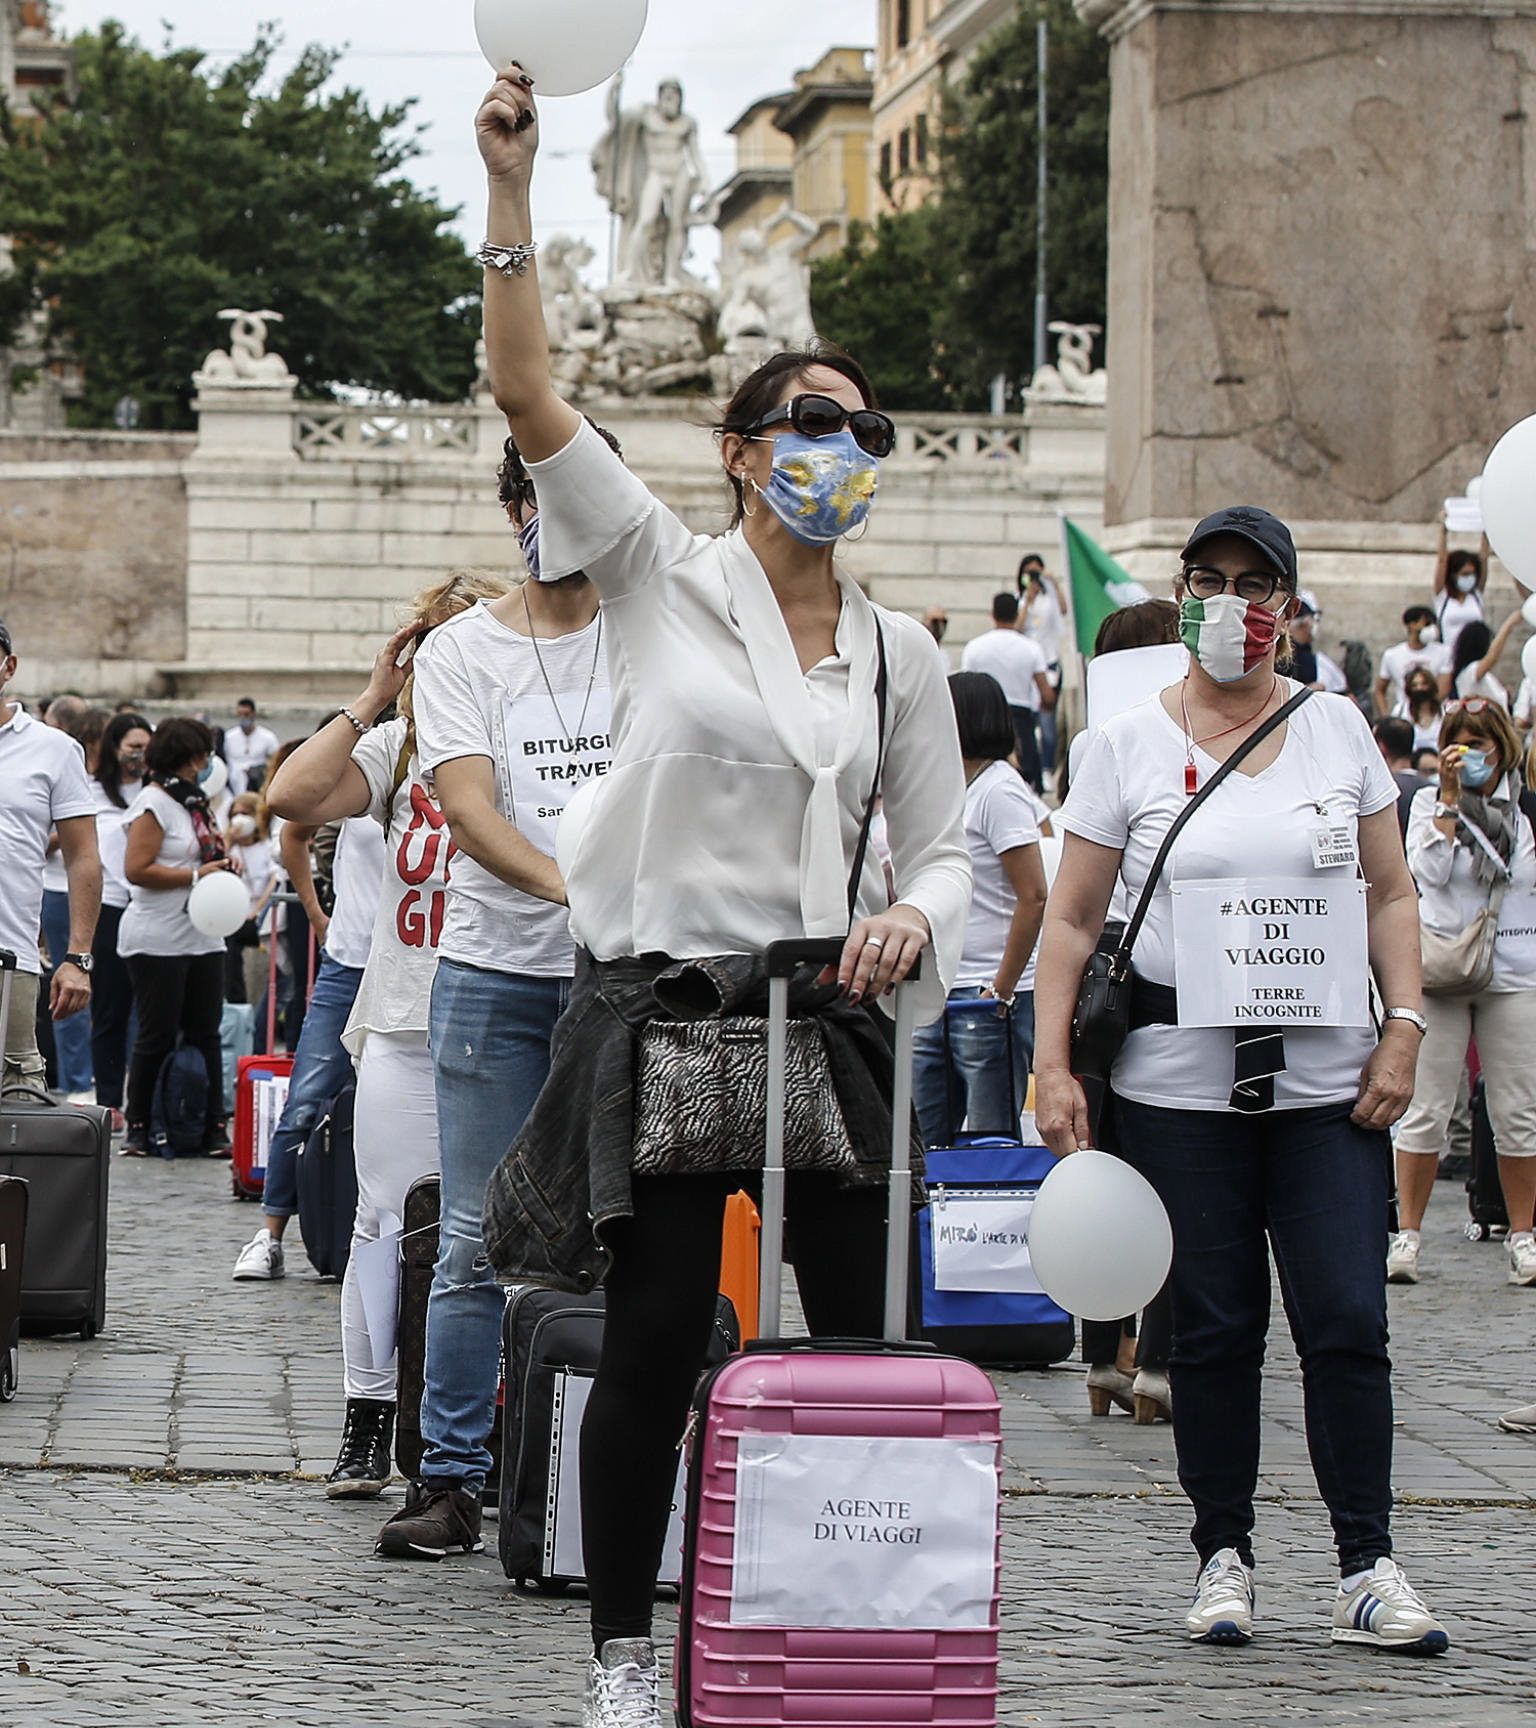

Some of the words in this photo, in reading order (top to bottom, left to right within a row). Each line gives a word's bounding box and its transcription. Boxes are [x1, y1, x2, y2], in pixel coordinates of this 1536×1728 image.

[1319, 851, 1355, 865] STEWARD
[1220, 898, 1328, 917] #AGENTE
[1264, 923, 1290, 940] DI
[1225, 948, 1325, 966] VIAGGIO
[1251, 988, 1306, 1001] TERRE
[1234, 1005, 1322, 1018] INCOGNITE
[820, 1499, 911, 1520] AGENTE
[814, 1523, 837, 1541] DI
[843, 1524, 922, 1545] VIAGGI
